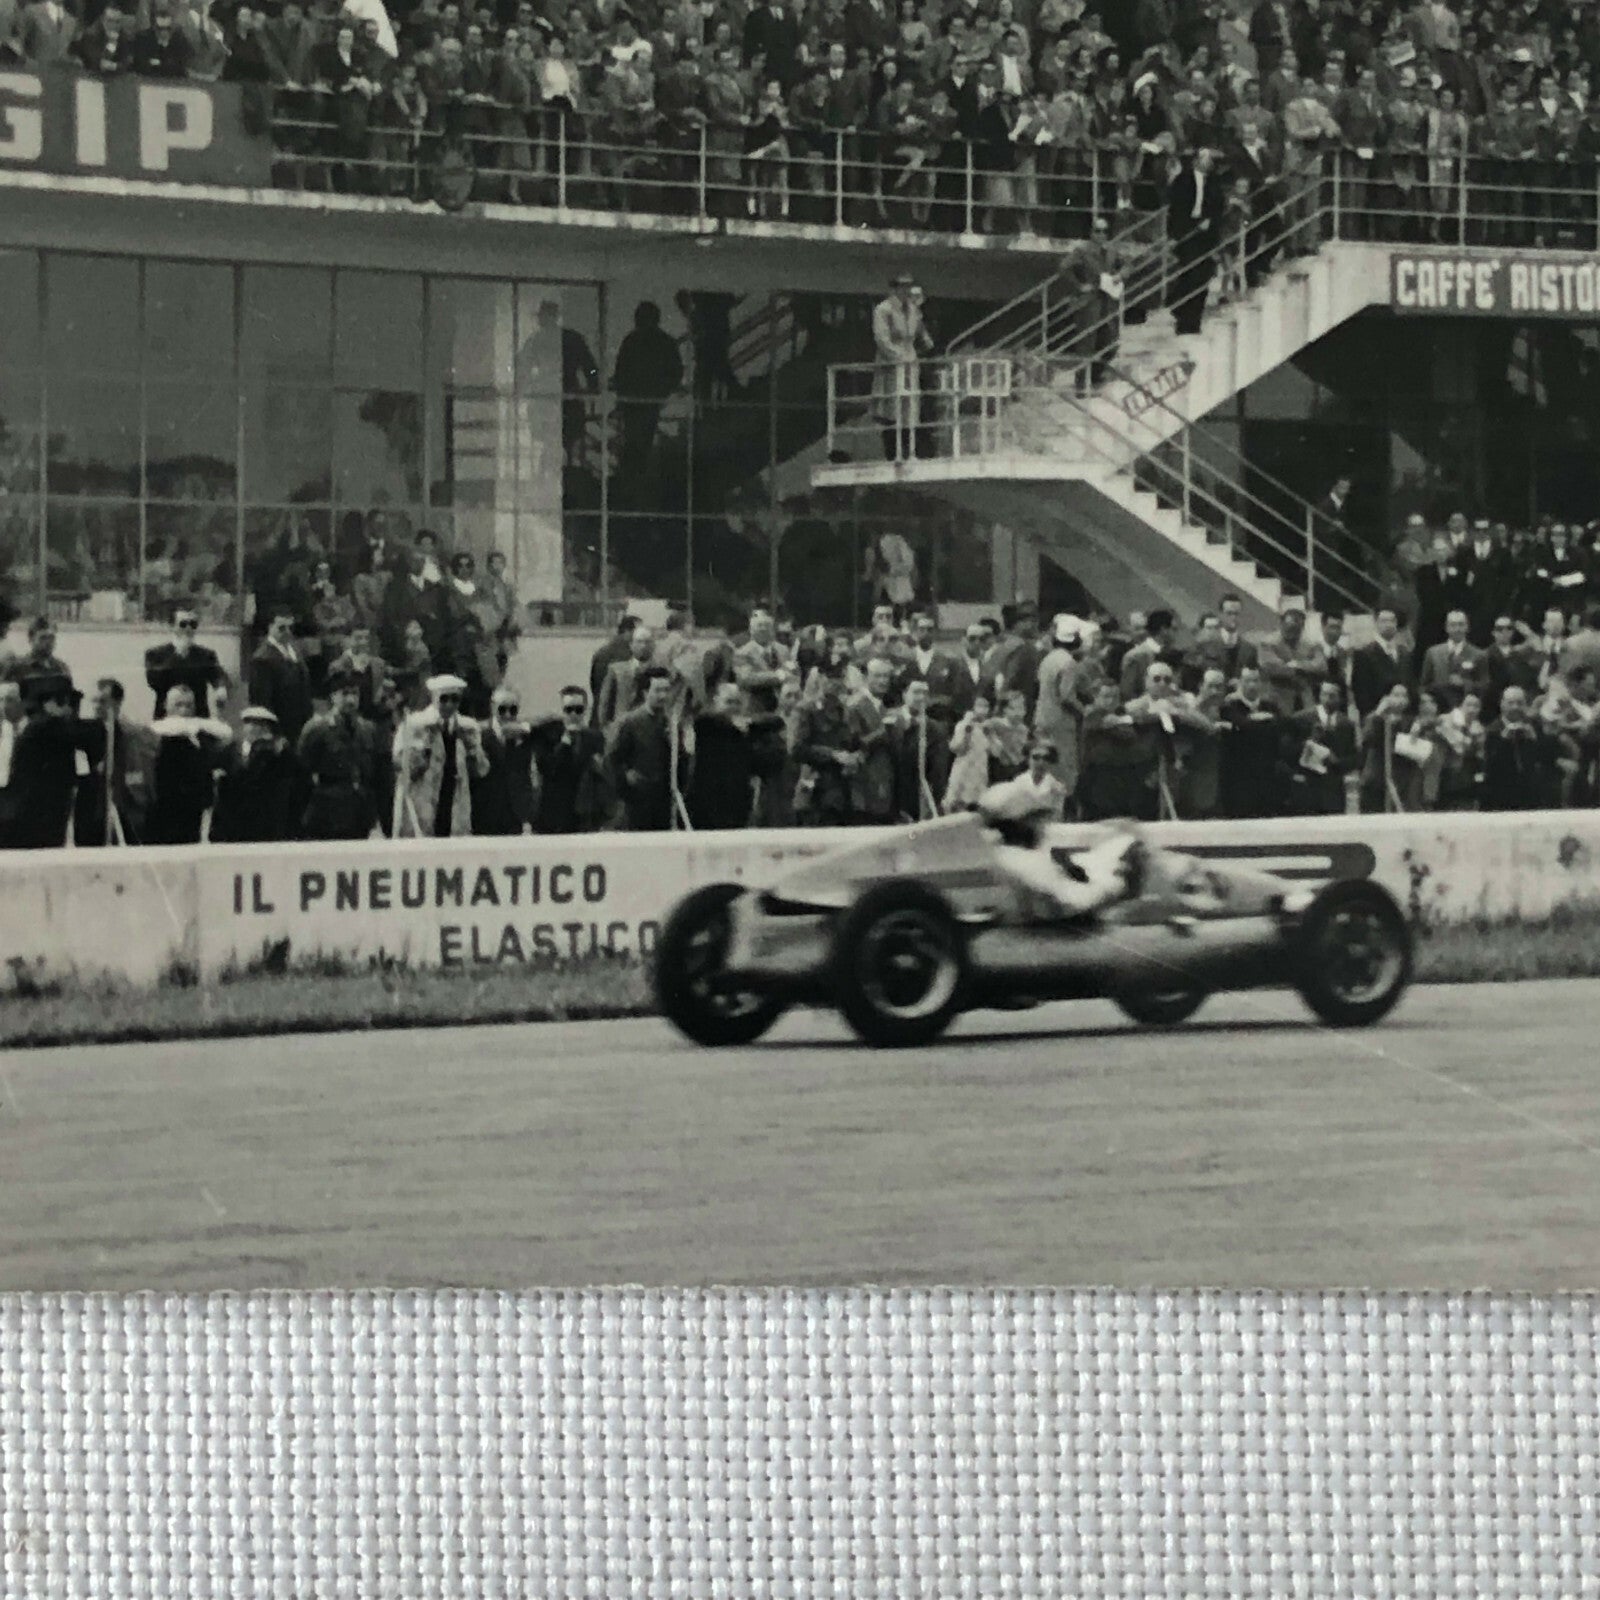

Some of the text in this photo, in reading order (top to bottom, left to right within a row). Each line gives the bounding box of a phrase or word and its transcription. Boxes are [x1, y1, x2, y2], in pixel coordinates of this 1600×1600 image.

[233, 863, 607, 914] IL PNEUMATICO
[439, 920, 660, 967] ELASTICO
